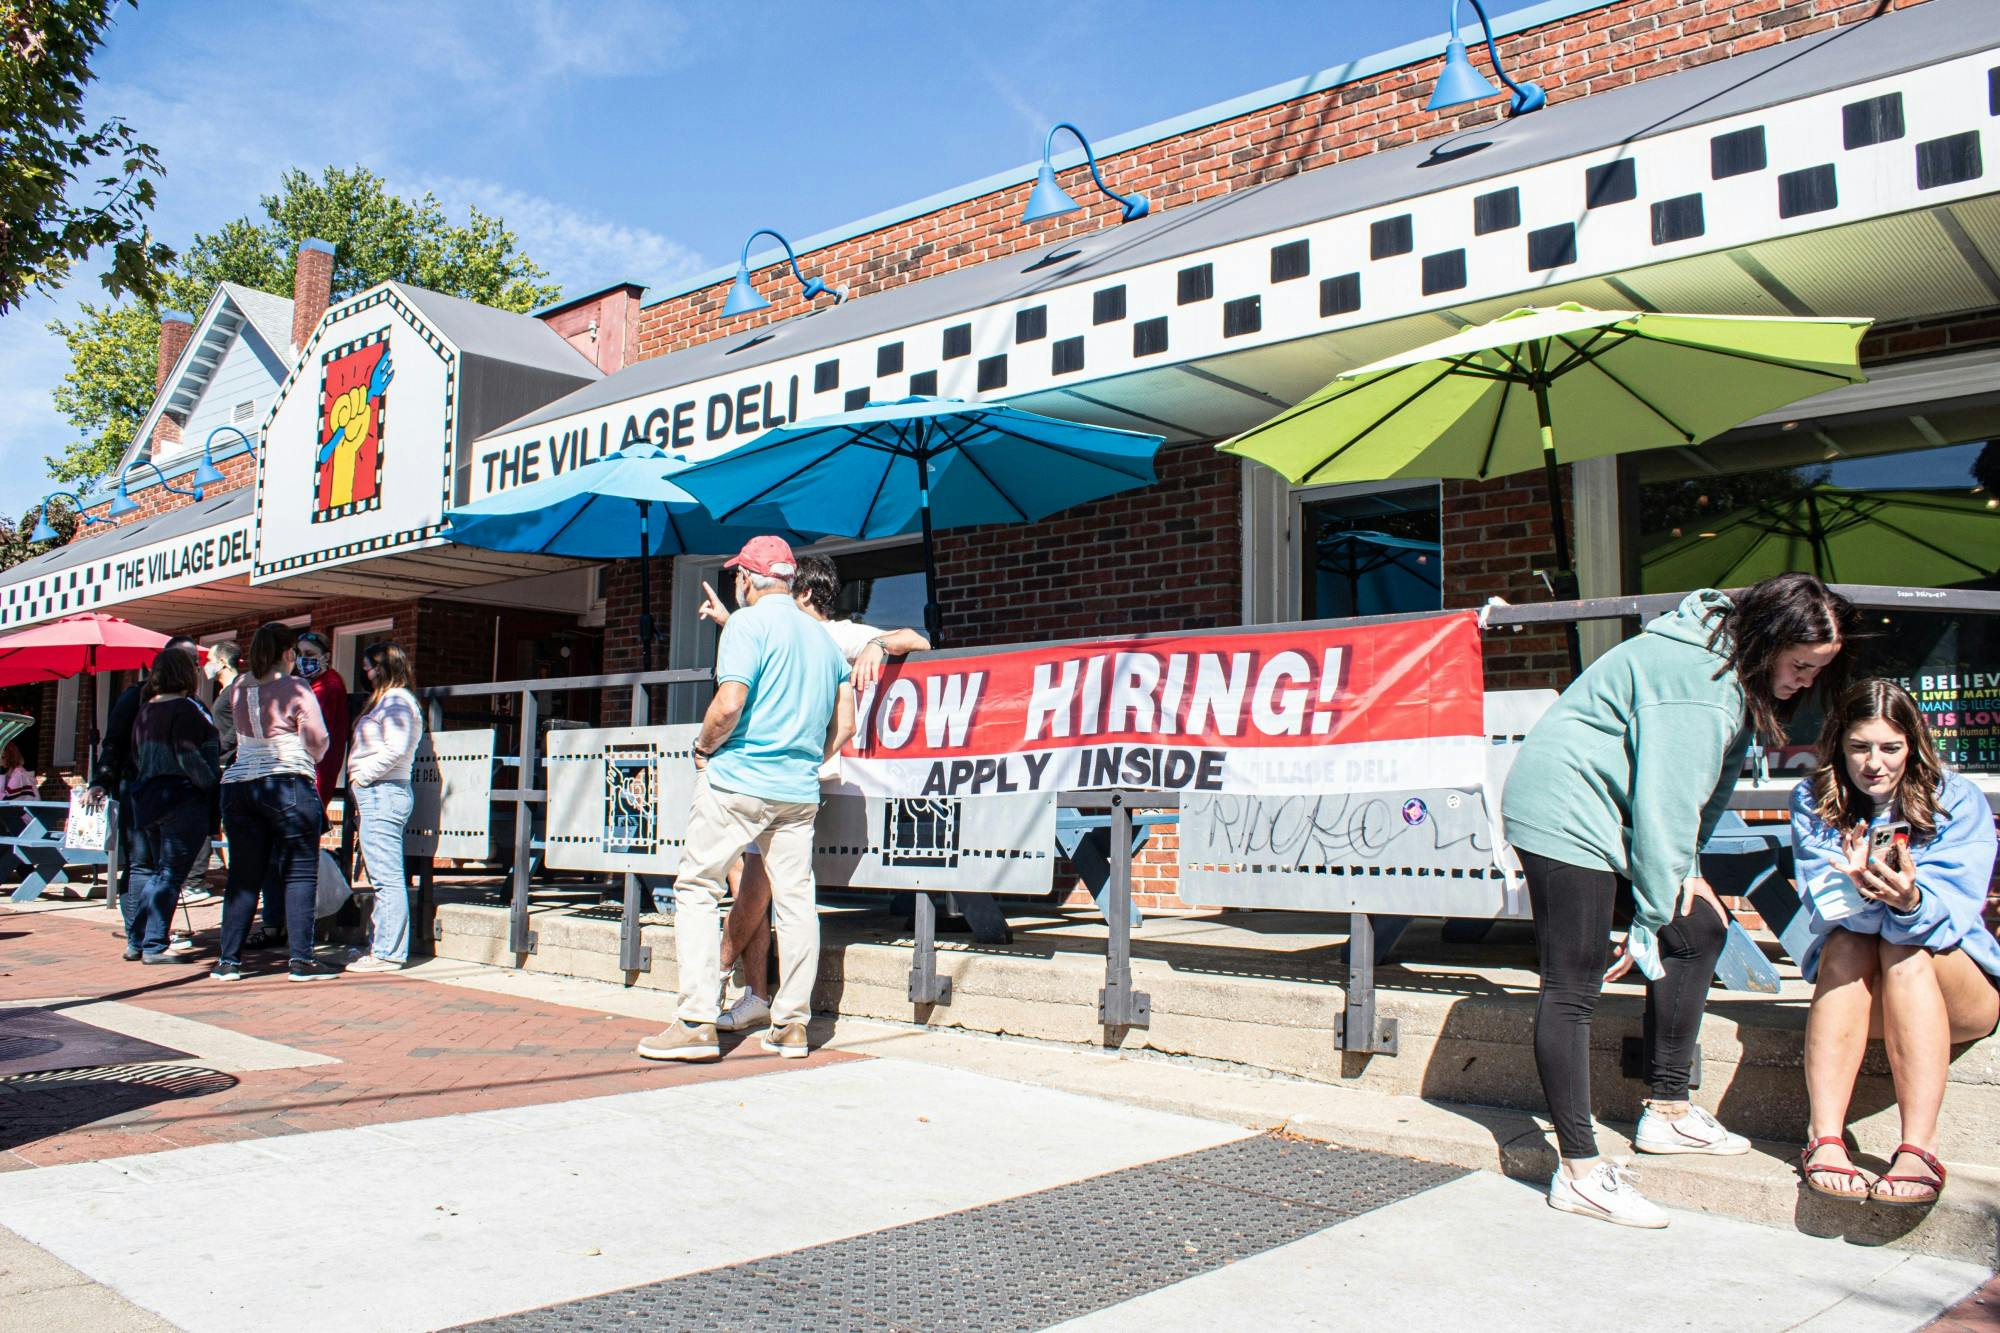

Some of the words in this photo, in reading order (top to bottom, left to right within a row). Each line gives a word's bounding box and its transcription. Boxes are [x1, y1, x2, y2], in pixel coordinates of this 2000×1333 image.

[482, 440, 541, 493] THE
[549, 400, 696, 476] VILLAGE
[706, 374, 799, 442] DELI
[116, 557, 145, 592] THE
[148, 539, 215, 585] VILLAGE
[218, 528, 252, 567] DEL
[1024, 648, 1344, 741] HIRING!
[1922, 690, 1958, 700] LIVES
[1963, 688, 2000, 698] MATT
[1918, 701, 1953, 711] MAN
[1937, 713, 1957, 726] IS
[1960, 727, 1989, 736] Human
[1956, 739, 1969, 750] IS
[1978, 737, 2000, 749] RE
[1951, 751, 1968, 762] IS
[1979, 751, 2000, 761] LI
[921, 752, 1053, 796] APPLY
[1078, 747, 1227, 790] INSIDE
